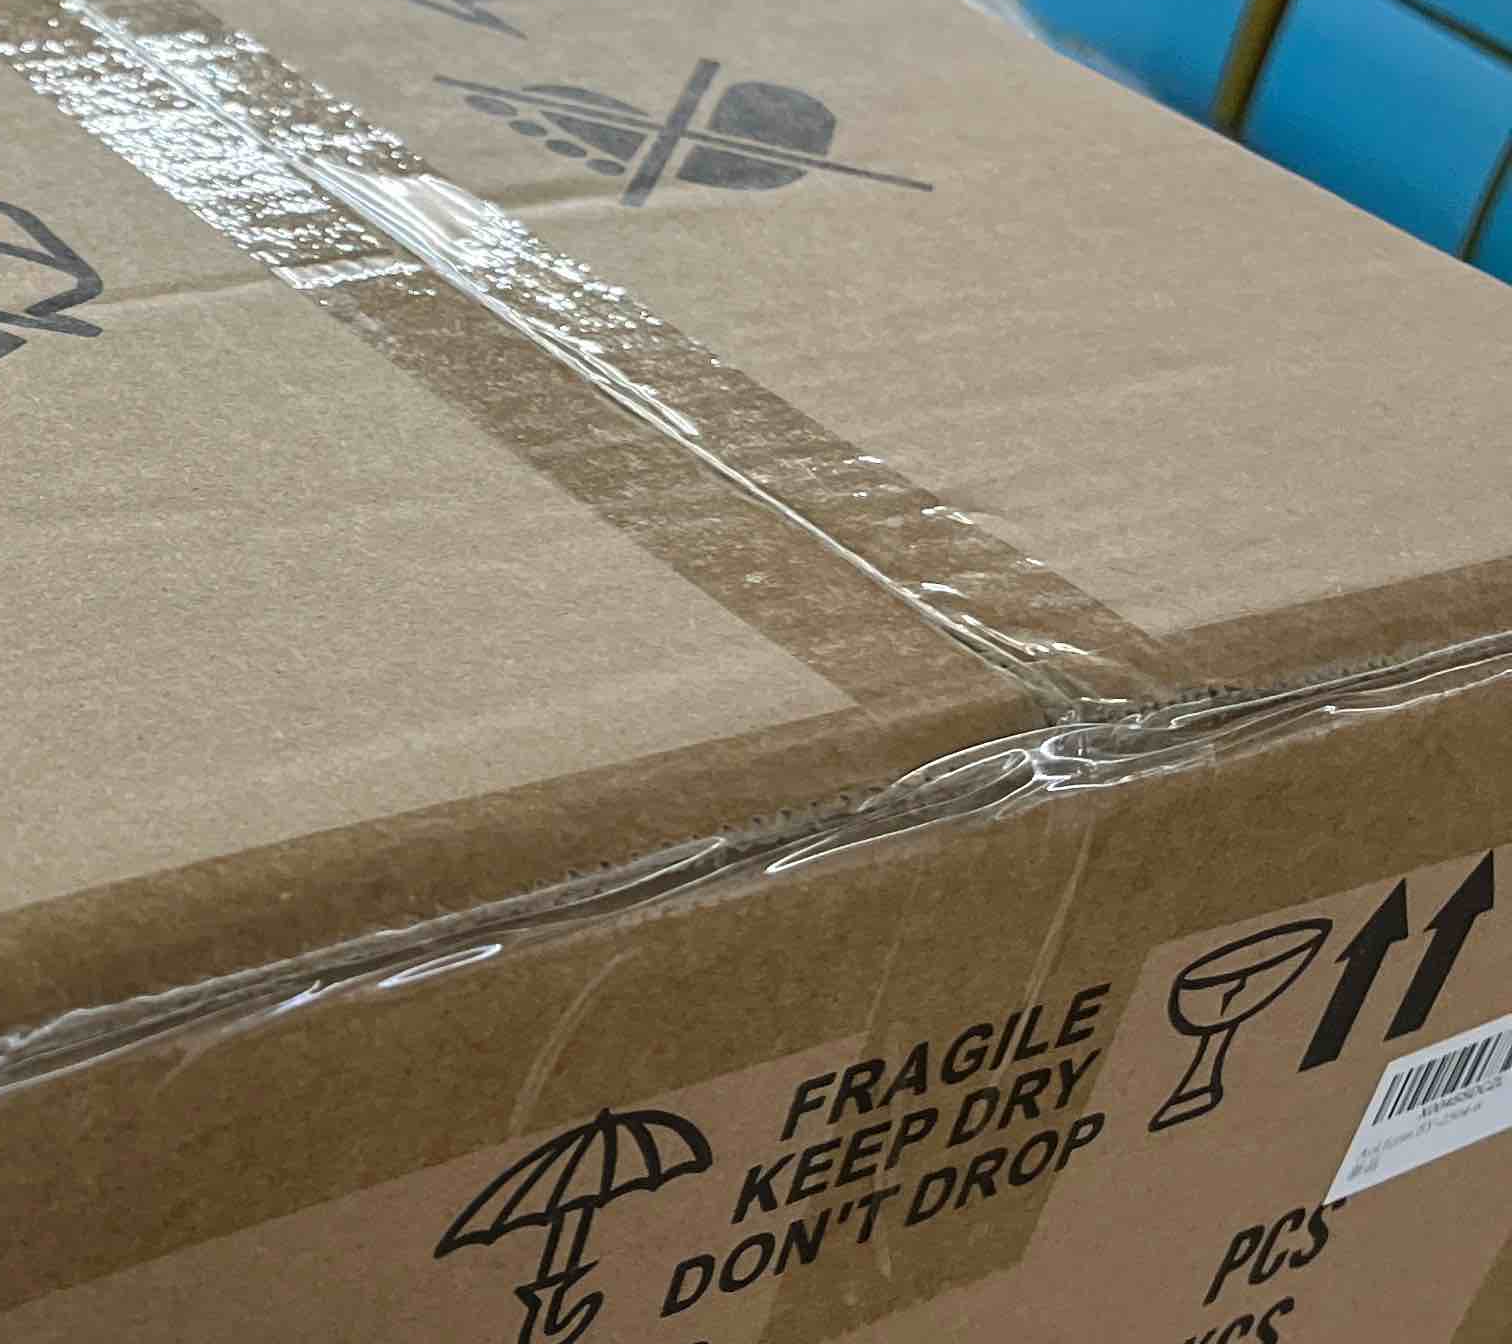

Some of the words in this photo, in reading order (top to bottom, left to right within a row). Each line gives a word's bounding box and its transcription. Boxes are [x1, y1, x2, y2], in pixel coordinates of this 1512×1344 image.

[732, 1108, 938, 1224] KEEP
[948, 1048, 1101, 1147] DRY
[781, 983, 1111, 1141] FRAGILE
[660, 1185, 900, 1317] DON'T
[905, 1113, 1105, 1226] DROP
[1203, 1197, 1347, 1307] PCS
